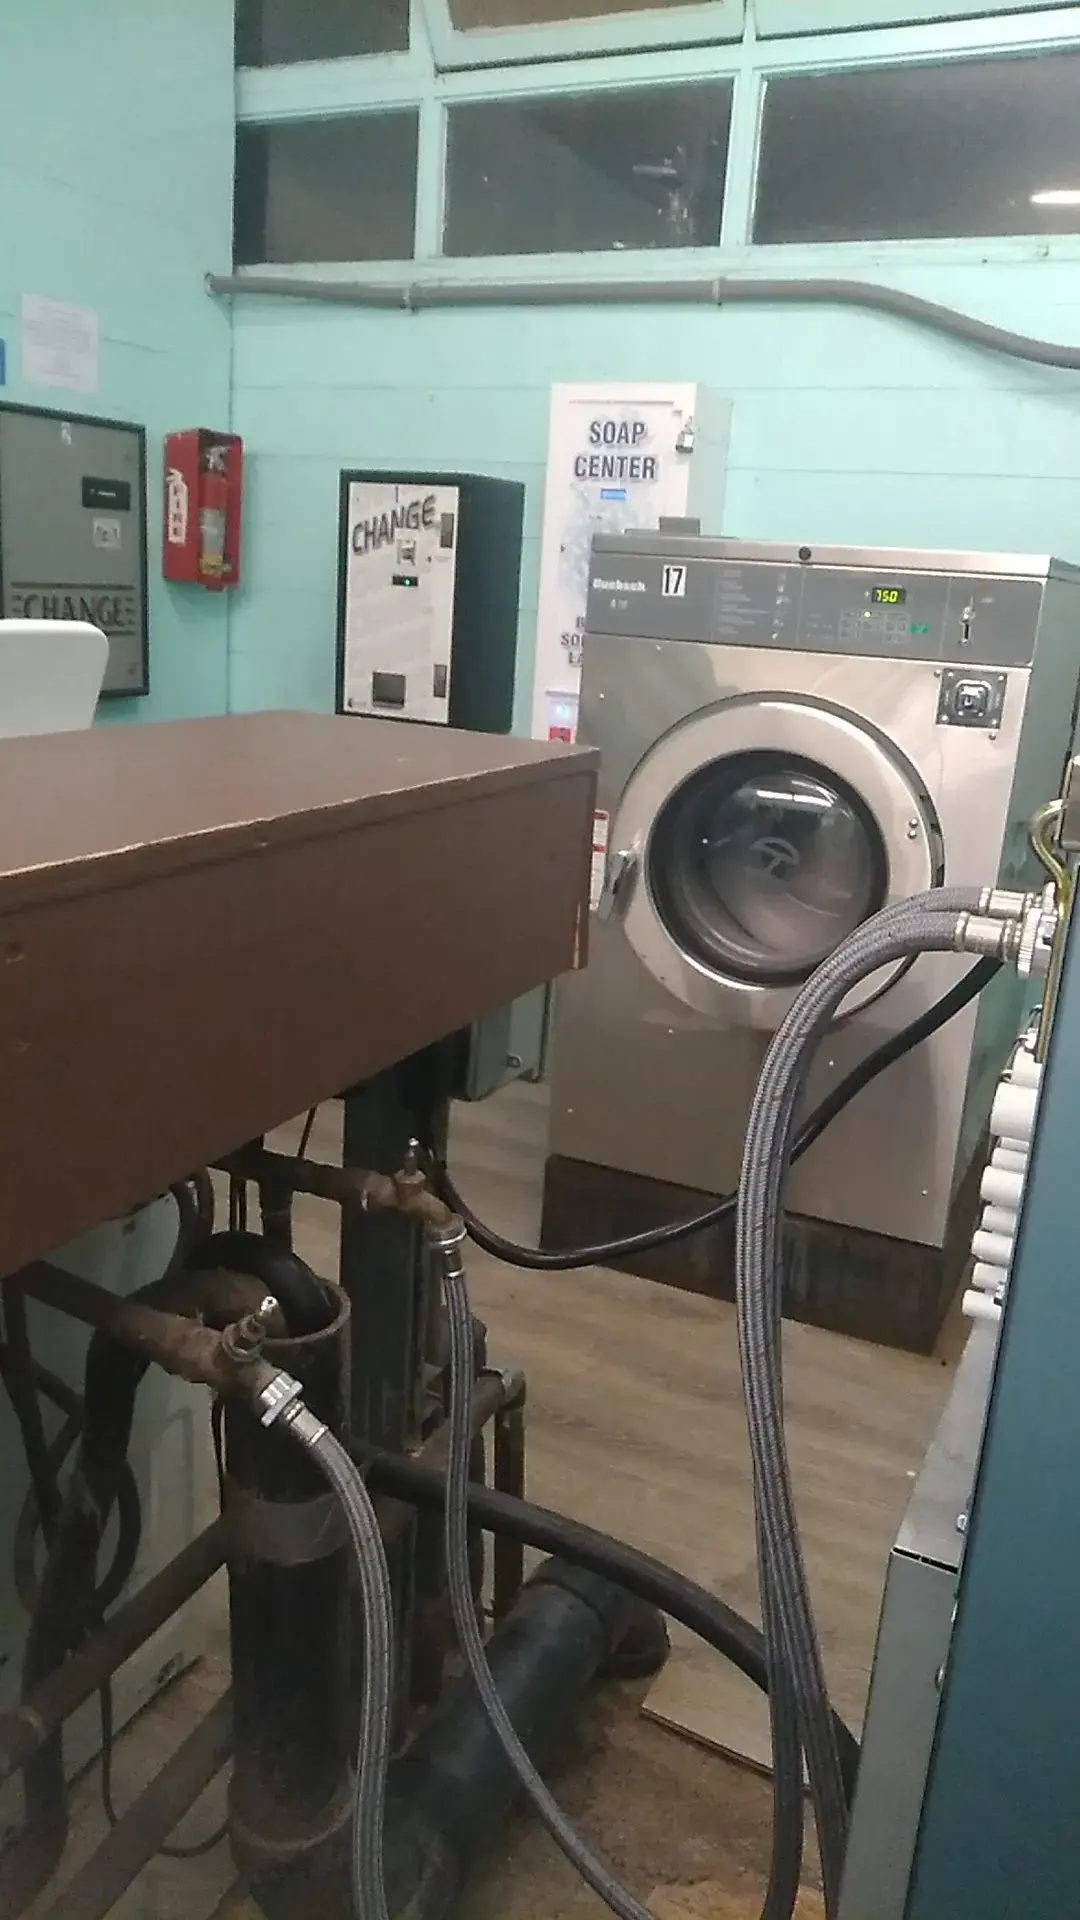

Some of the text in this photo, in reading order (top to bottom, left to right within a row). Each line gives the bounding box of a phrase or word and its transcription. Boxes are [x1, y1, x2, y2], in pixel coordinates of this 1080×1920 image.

[589, 420, 646, 444] SOAP
[574, 455, 656, 479] CENTER
[352, 494, 436, 554] CHANGE
[665, 567, 684, 594] 17
[876, 589, 899, 603] 750
[23, 593, 126, 627] CHANGE
